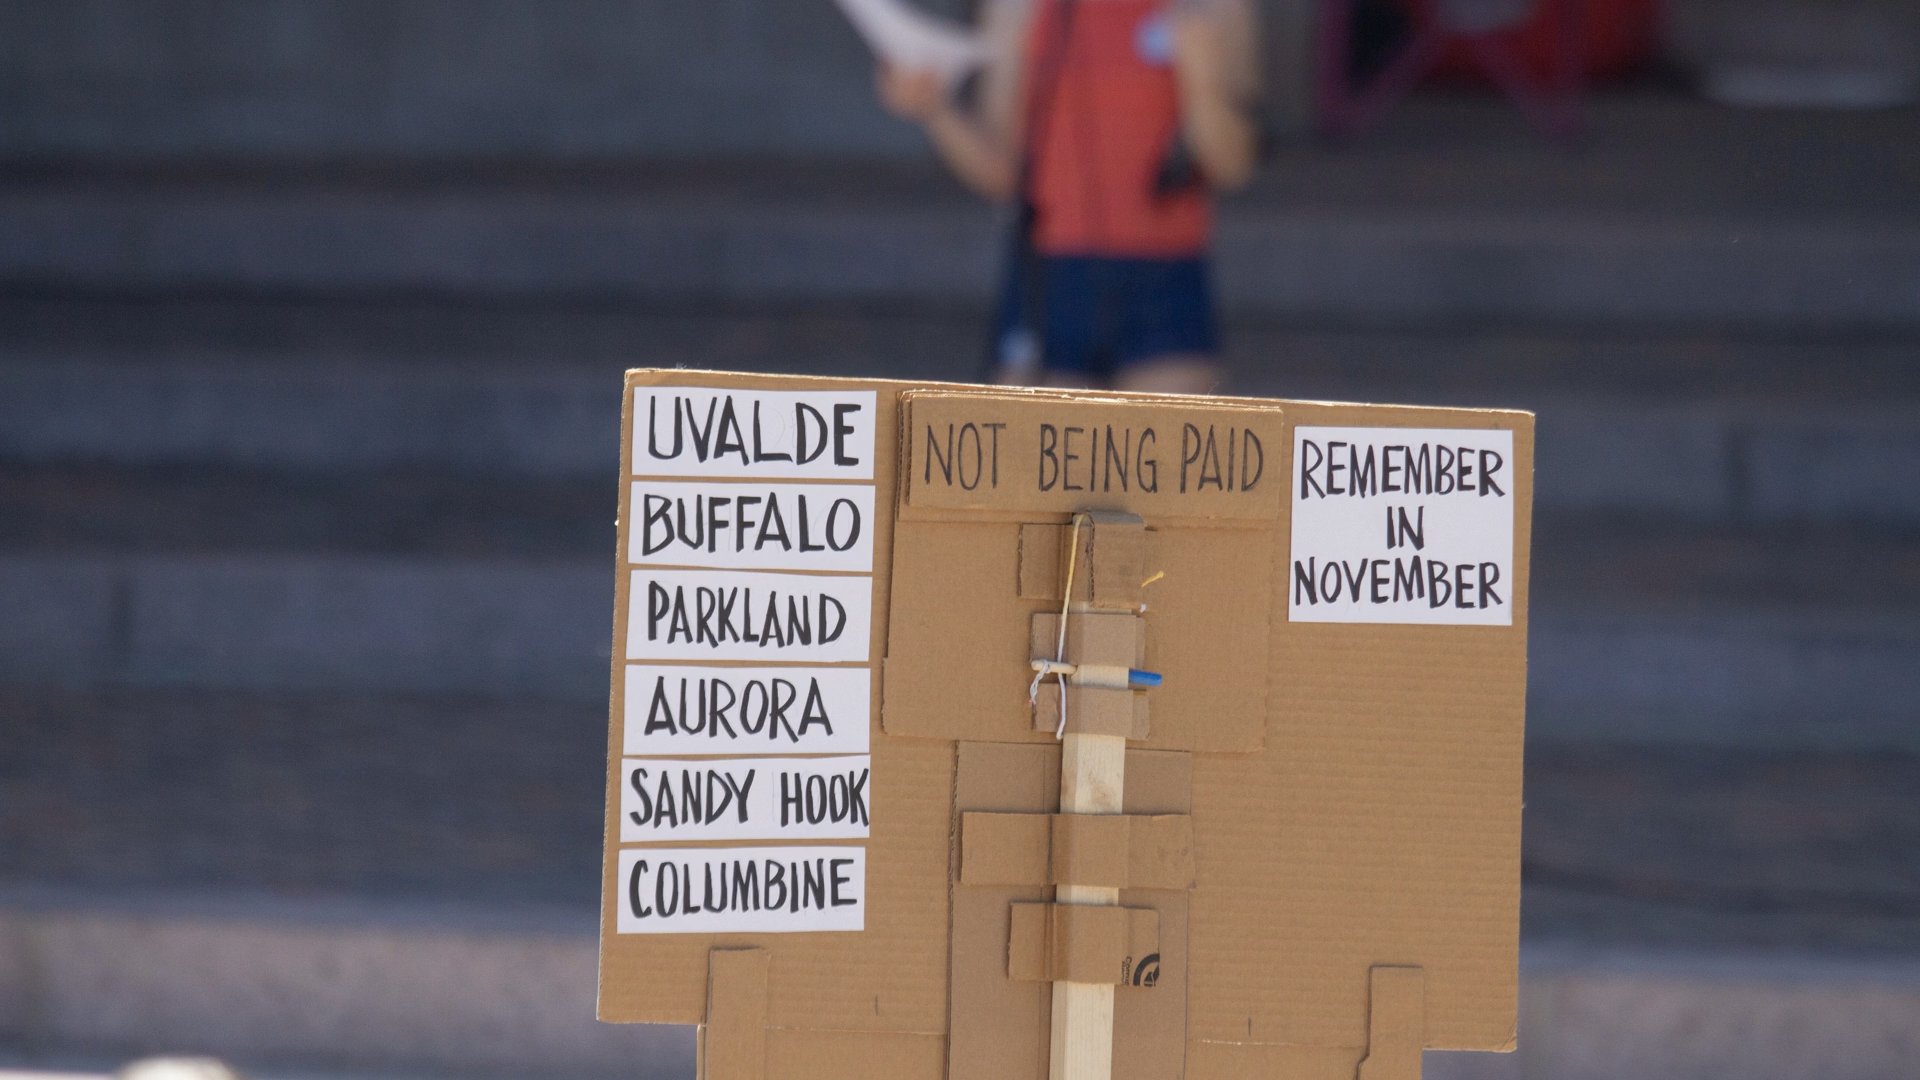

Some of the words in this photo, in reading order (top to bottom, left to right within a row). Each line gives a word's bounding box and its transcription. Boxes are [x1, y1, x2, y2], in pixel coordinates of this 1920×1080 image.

[648, 395, 862, 467] UVALDE
[925, 421, 1007, 491] NOT
[1038, 422, 1158, 494] BEING
[1180, 422, 1264, 494] PAID
[1301, 439, 1506, 500] REMEMBER
[642, 491, 861, 556] BUFFALO
[1386, 505, 1425, 551] IN
[647, 580, 847, 648] PARKLAND
[1294, 555, 1503, 610] NOVEMBER
[644, 675, 834, 744] AURORA
[629, 767, 756, 829] SANDY
[780, 768, 870, 828] HOOK
[629, 858, 857, 919] COLUMBINE
